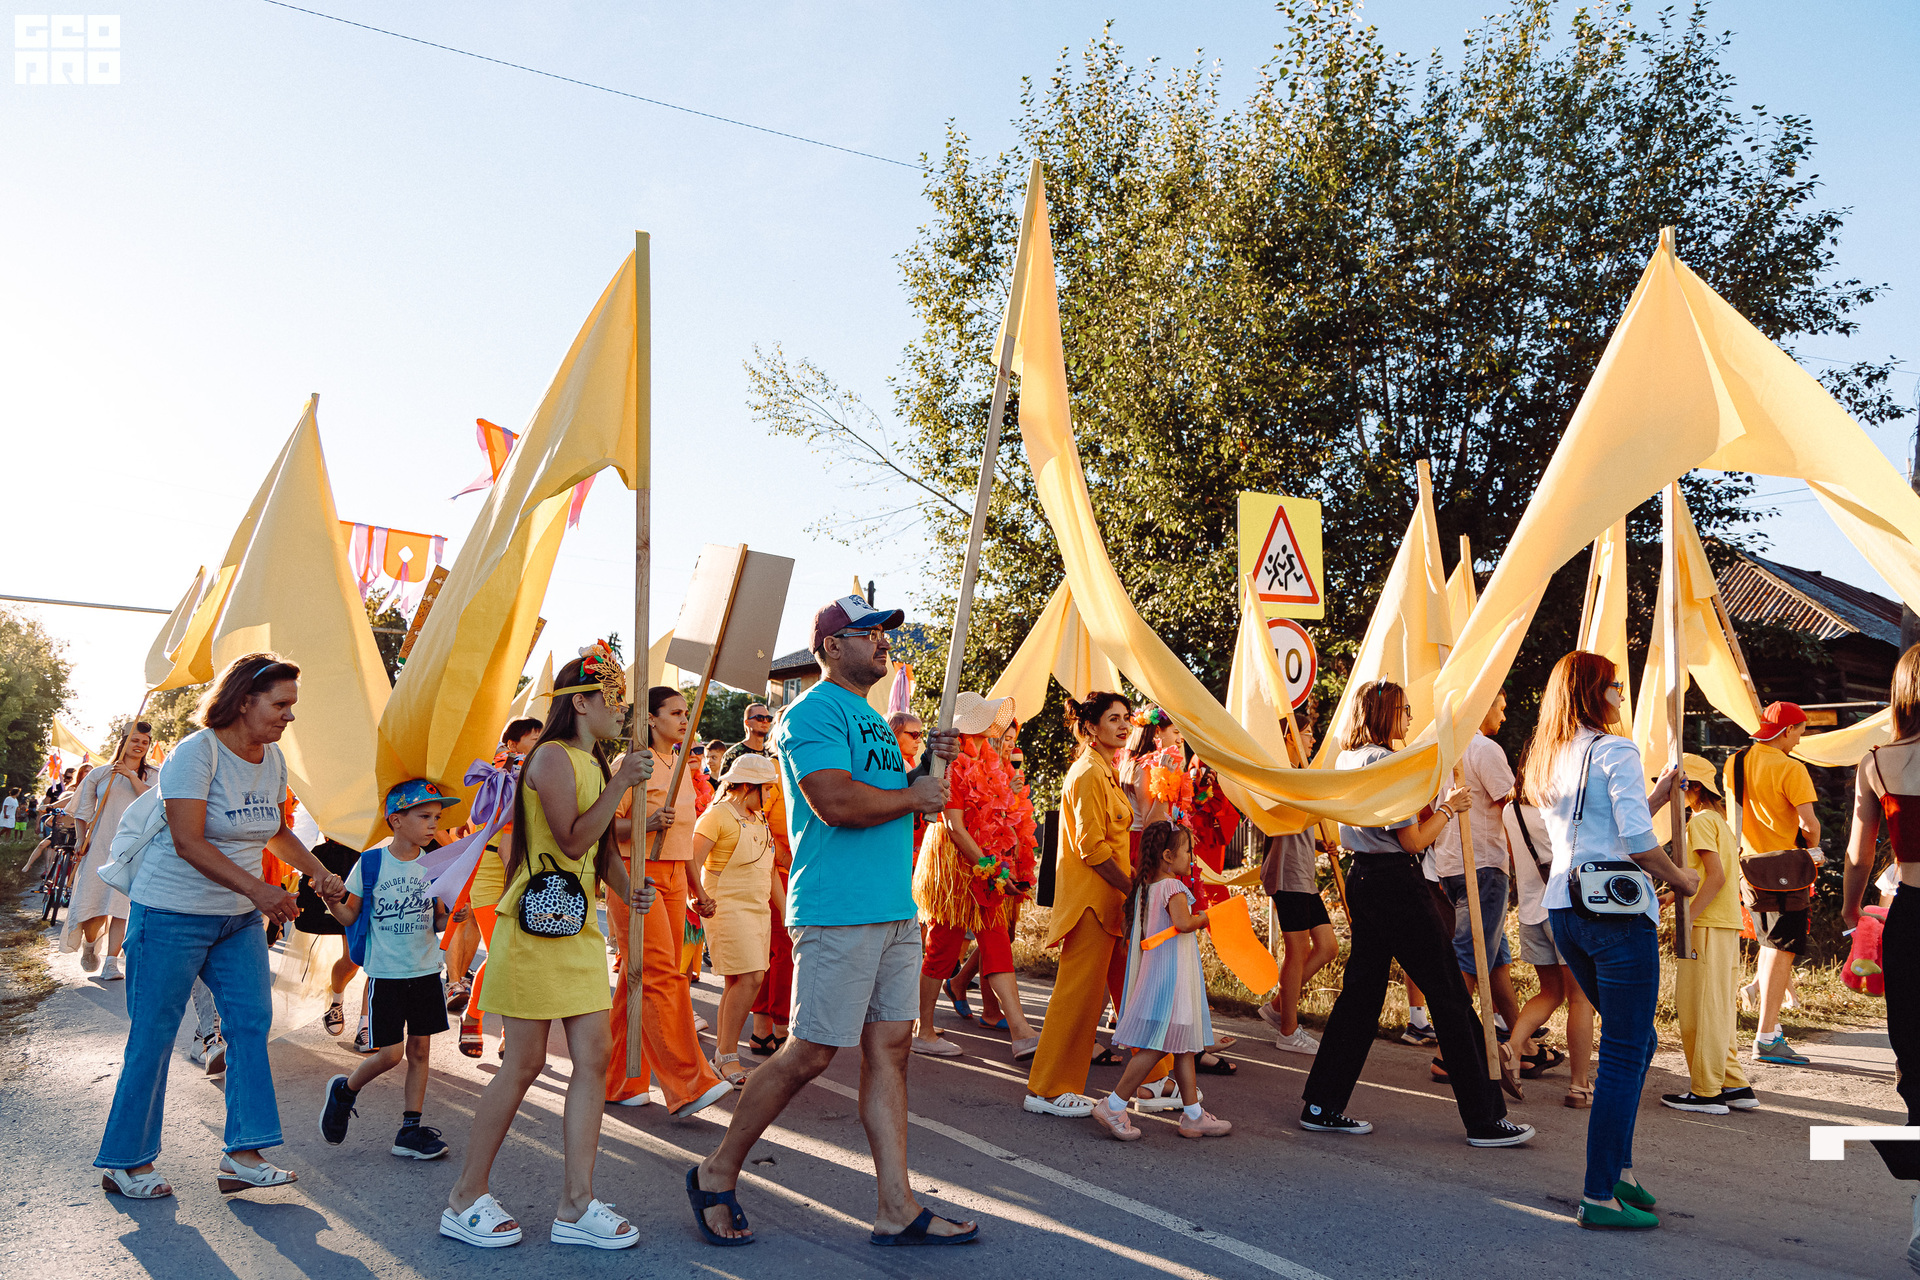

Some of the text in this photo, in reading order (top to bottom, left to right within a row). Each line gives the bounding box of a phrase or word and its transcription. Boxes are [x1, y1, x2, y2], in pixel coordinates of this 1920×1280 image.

[1274, 648, 1302, 683] 0
[225, 806, 280, 827] VIRGINI
[375, 897, 433, 920] Surfing
[393, 923, 415, 933] SURF
